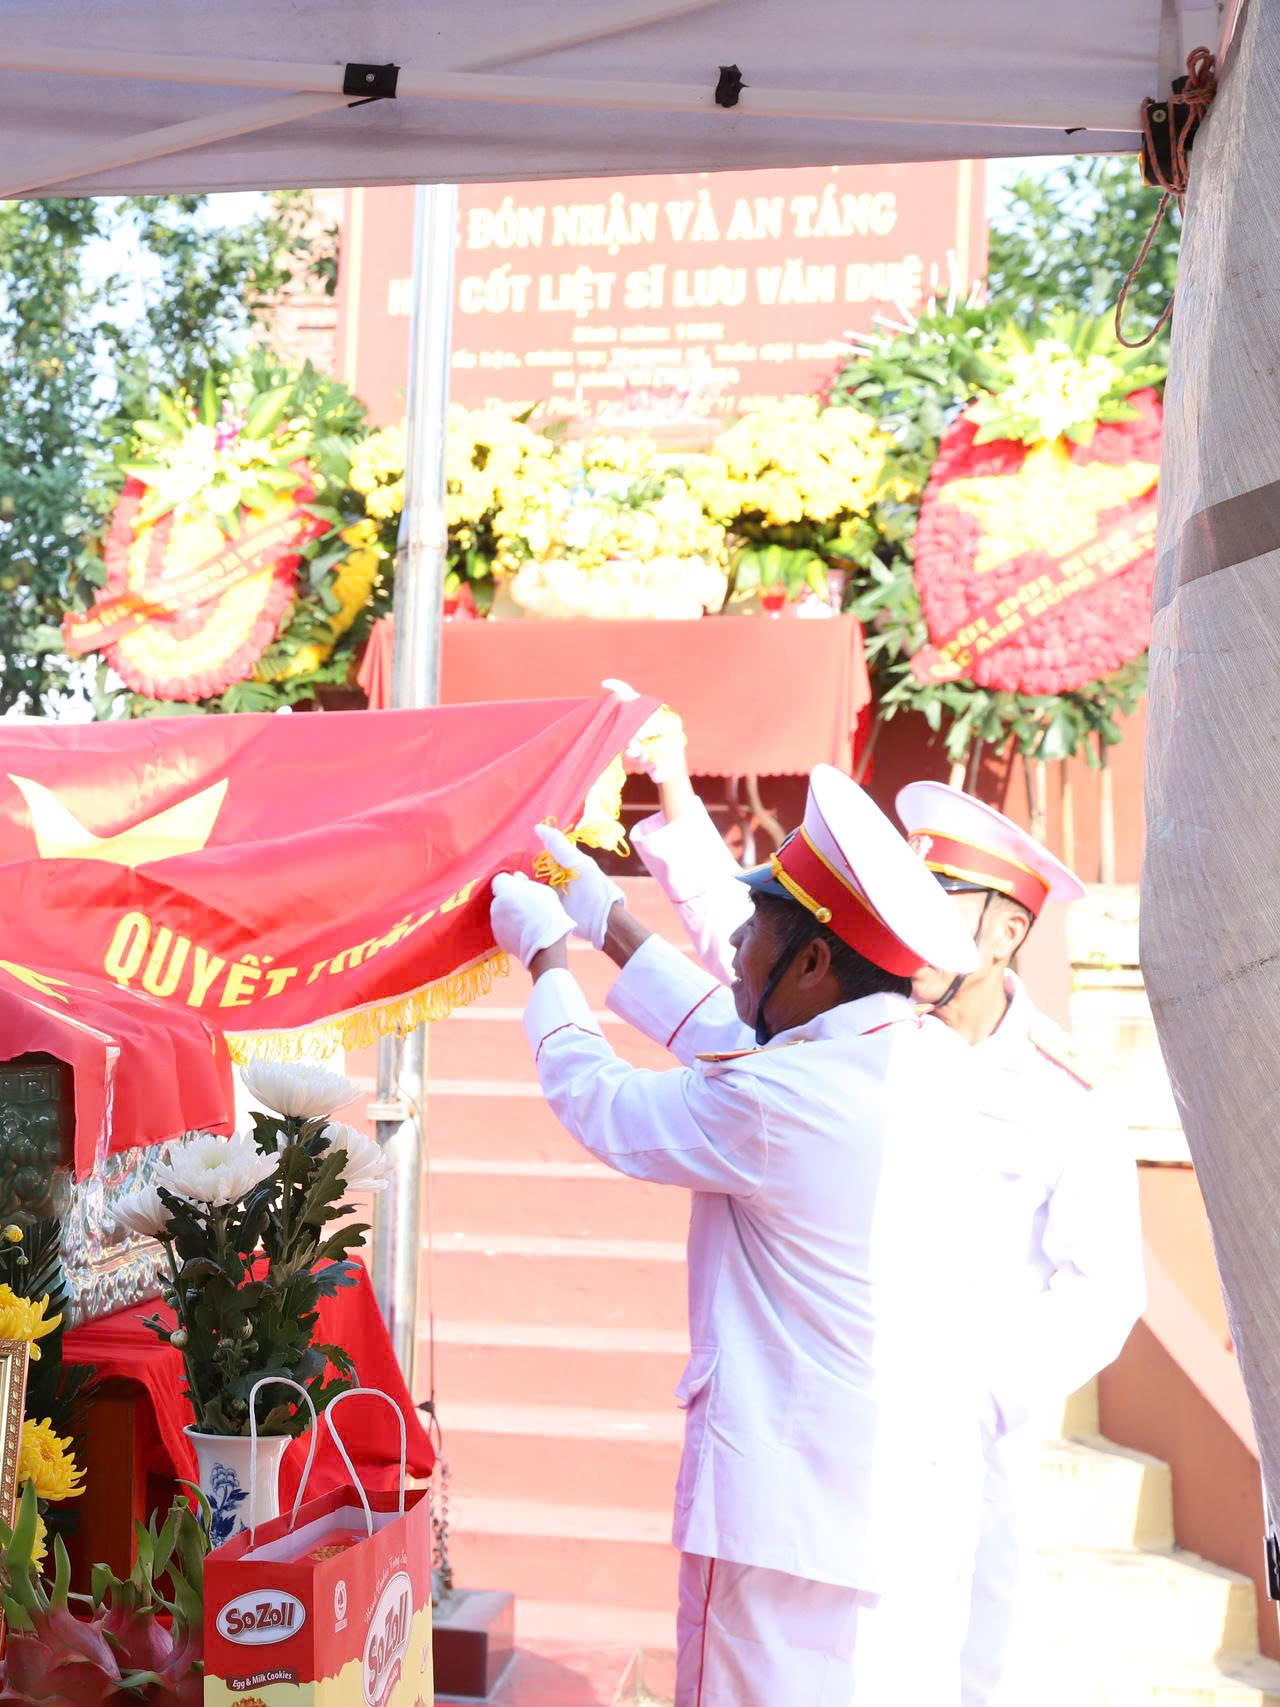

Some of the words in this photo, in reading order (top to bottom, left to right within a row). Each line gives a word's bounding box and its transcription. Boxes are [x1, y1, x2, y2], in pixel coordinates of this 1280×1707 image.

[467, 196, 545, 249] ĐÓN
[552, 191, 659, 255] NHẬN
[665, 188, 720, 243] VÀ
[726, 196, 785, 241] AN
[790, 183, 897, 238] TÁNG
[459, 263, 532, 313] CỐT
[538, 265, 616, 318] LIỆT
[756, 257, 836, 304] VĂN
[104, 911, 298, 1008] QUYẾT
[225, 1602, 296, 1635] SoZoll
[368, 1590, 408, 1696] SoZoll
[232, 1679, 246, 1690] Egg
[252, 1674, 267, 1685] Milk
[266, 1670, 292, 1681] Cookies
